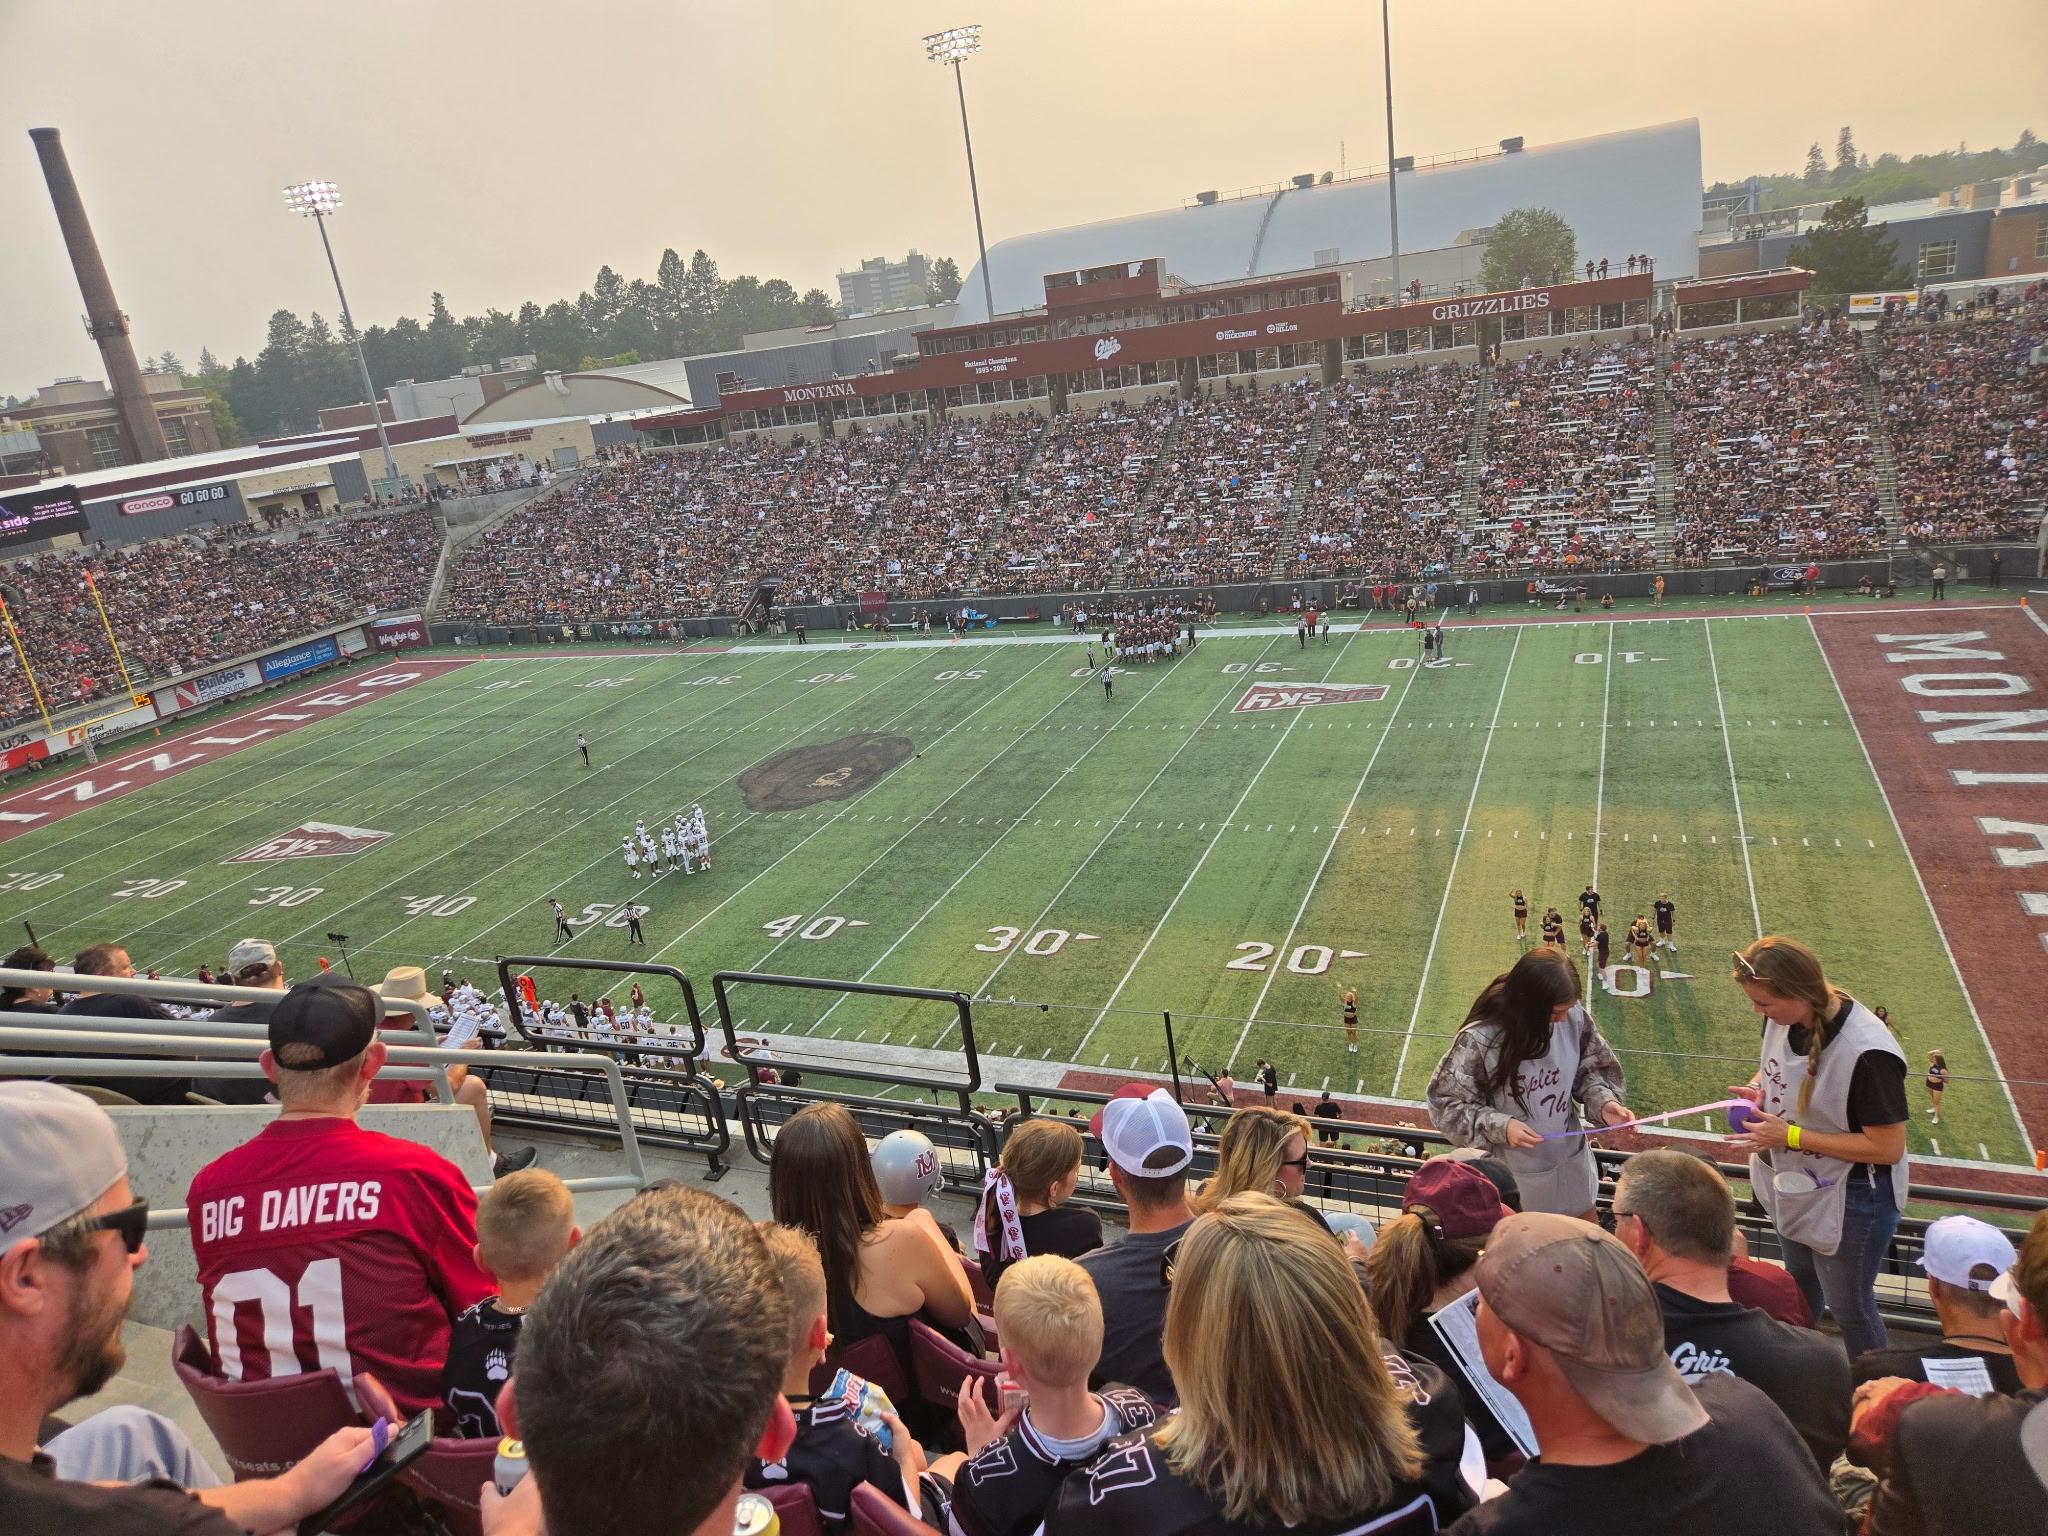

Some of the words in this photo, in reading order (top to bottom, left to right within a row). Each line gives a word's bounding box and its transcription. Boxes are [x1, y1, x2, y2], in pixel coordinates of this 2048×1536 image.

[1433, 292, 1549, 320] GRIZZLIES
[784, 383, 856, 402] MONTANA
[180, 491, 194, 504] GO
[195, 489, 209, 502] GO
[210, 486, 224, 500] GO
[265, 649, 312, 672] Allegiance
[1221, 662, 1282, 674] 30
[197, 668, 245, 691] Builders
[933, 669, 989, 680] 50
[201, 680, 249, 701] FirstSource
[88, 724, 104, 733] First
[111, 878, 188, 898] 20
[248, 886, 325, 907] 30
[405, 895, 478, 917] 40
[762, 914, 846, 940] 40
[975, 925, 1071, 957] 30
[1225, 940, 1335, 976] 20
[1541, 1091, 1570, 1118] Th
[202, 1196, 245, 1243] BIG
[260, 1181, 381, 1232] DAVERS
[1670, 1341, 1736, 1385] Griz
